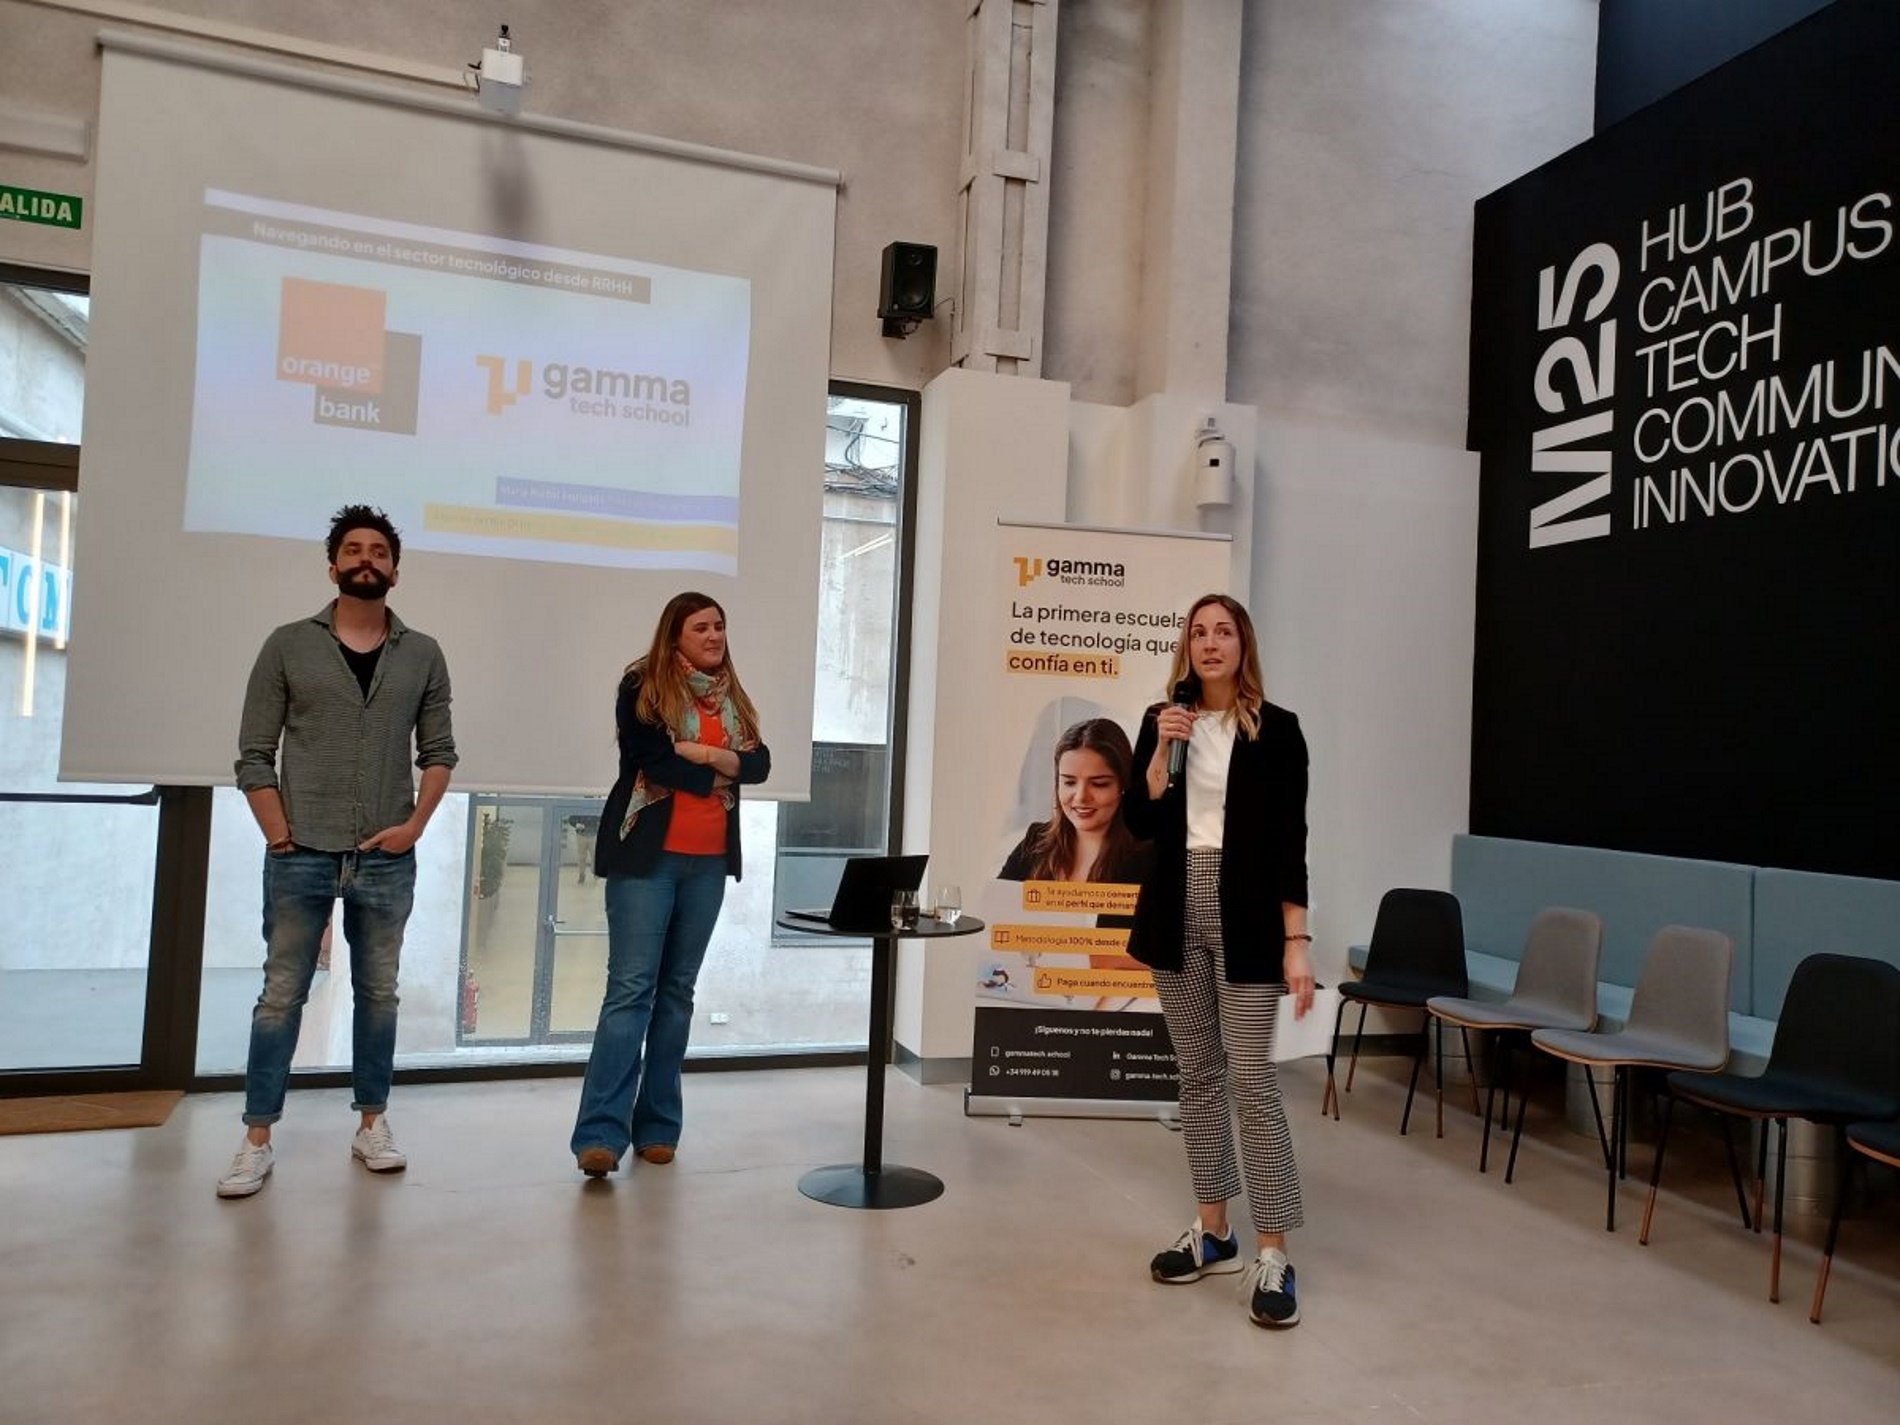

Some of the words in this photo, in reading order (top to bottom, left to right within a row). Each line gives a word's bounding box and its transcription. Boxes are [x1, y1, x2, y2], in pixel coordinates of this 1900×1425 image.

[0, 192, 72, 222] ALIDA
[1640, 176, 1754, 272] HUB
[253, 221, 351, 249] Navegando
[353, 241, 374, 255] en
[376, 242, 391, 257] el
[394, 247, 446, 267] sector
[449, 255, 541, 280] tecnológico
[543, 269, 590, 288] desde
[592, 276, 633, 295] RRHH
[1638, 192, 1893, 334] CAMPUS
[1635, 302, 1782, 398] TECH
[282, 356, 371, 387] orange
[543, 362, 691, 406] gamma
[319, 395, 381, 424] bank
[1529, 242, 1621, 549] M25
[569, 396, 616, 417] tech
[622, 403, 690, 428] school
[1634, 423, 1900, 530] INNOVATI
[1046, 558, 1125, 577] gamma
[1060, 574, 1086, 585] tech
[1088, 576, 1125, 588] school
[1011, 602, 1033, 619] La
[1037, 604, 1110, 623] primera
[1115, 612, 1185, 629] escuela
[1010, 628, 1035, 645] de
[1040, 630, 1141, 654] tecnología
[1146, 639, 1179, 656] que
[1009, 653, 1069, 673] confía
[1073, 661, 1096, 674] en
[1100, 659, 1118, 675] ti.
[1057, 978, 1079, 989] Paga
[1079, 979, 1111, 988] cuando
